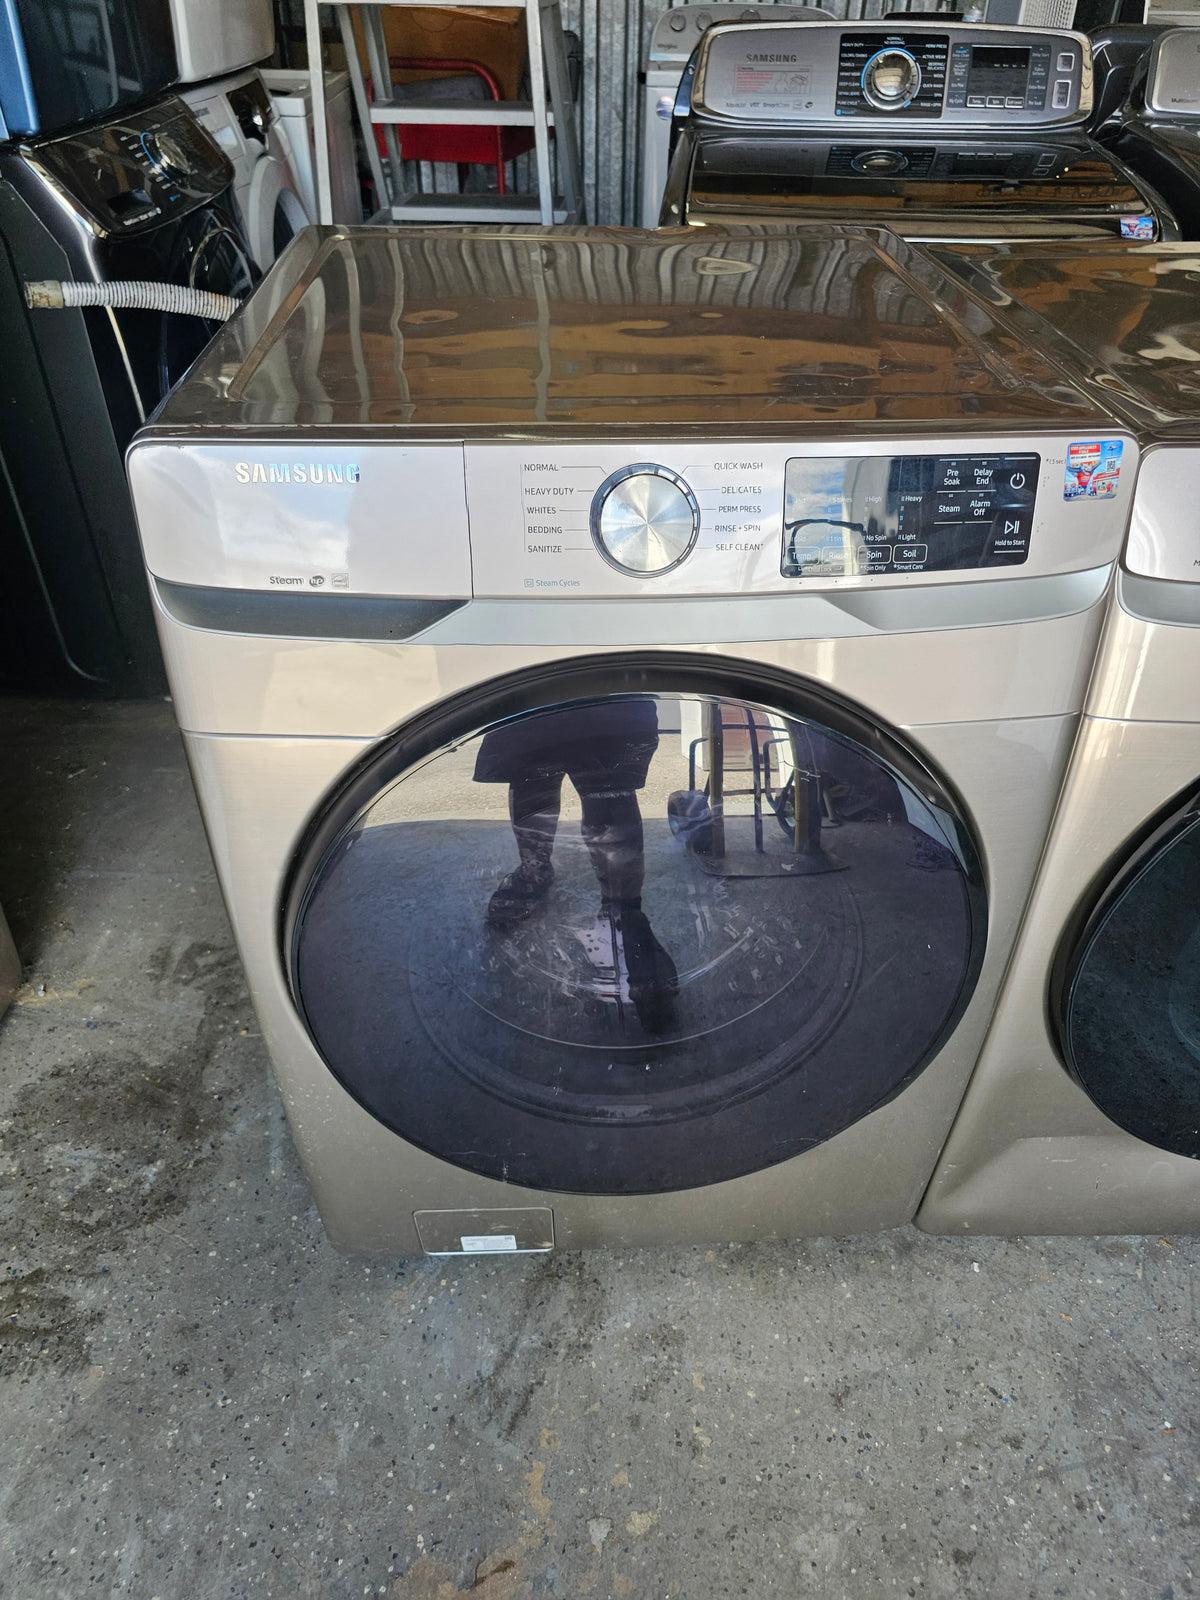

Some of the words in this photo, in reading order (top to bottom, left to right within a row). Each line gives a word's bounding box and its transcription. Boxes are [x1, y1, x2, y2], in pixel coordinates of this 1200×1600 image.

[746, 54, 797, 62] SAMSUNG
[714, 462, 738, 471] QUICK
[740, 462, 763, 470] WASH
[234, 462, 361, 484] SAMSUNG
[946, 469, 959, 477] Pre
[974, 468, 993, 477] Delay
[943, 478, 960, 486] Soak
[976, 477, 989, 485] End
[525, 487, 551, 495] HEAVY
[553, 487, 574, 495] DUTY
[721, 486, 762, 494] DELICATES
[970, 500, 991, 508] Alarm
[527, 506, 556, 514] WHITES
[718, 505, 738, 513] PERM
[739, 505, 762, 513] PRESS
[938, 505, 960, 513] Steam
[973, 508, 986, 516] Off
[528, 526, 562, 534] BEDDING
[714, 524, 737, 532] RINSE
[743, 524, 761, 532] SPIN
[528, 545, 562, 553] SANITIZE
[715, 543, 733, 551] SELF
[866, 550, 882, 559] Spin
[903, 550, 917, 558] Soil
[875, 564, 886, 572] Only
[269, 576, 303, 585] Steam
[559, 579, 581, 588] Cycles
